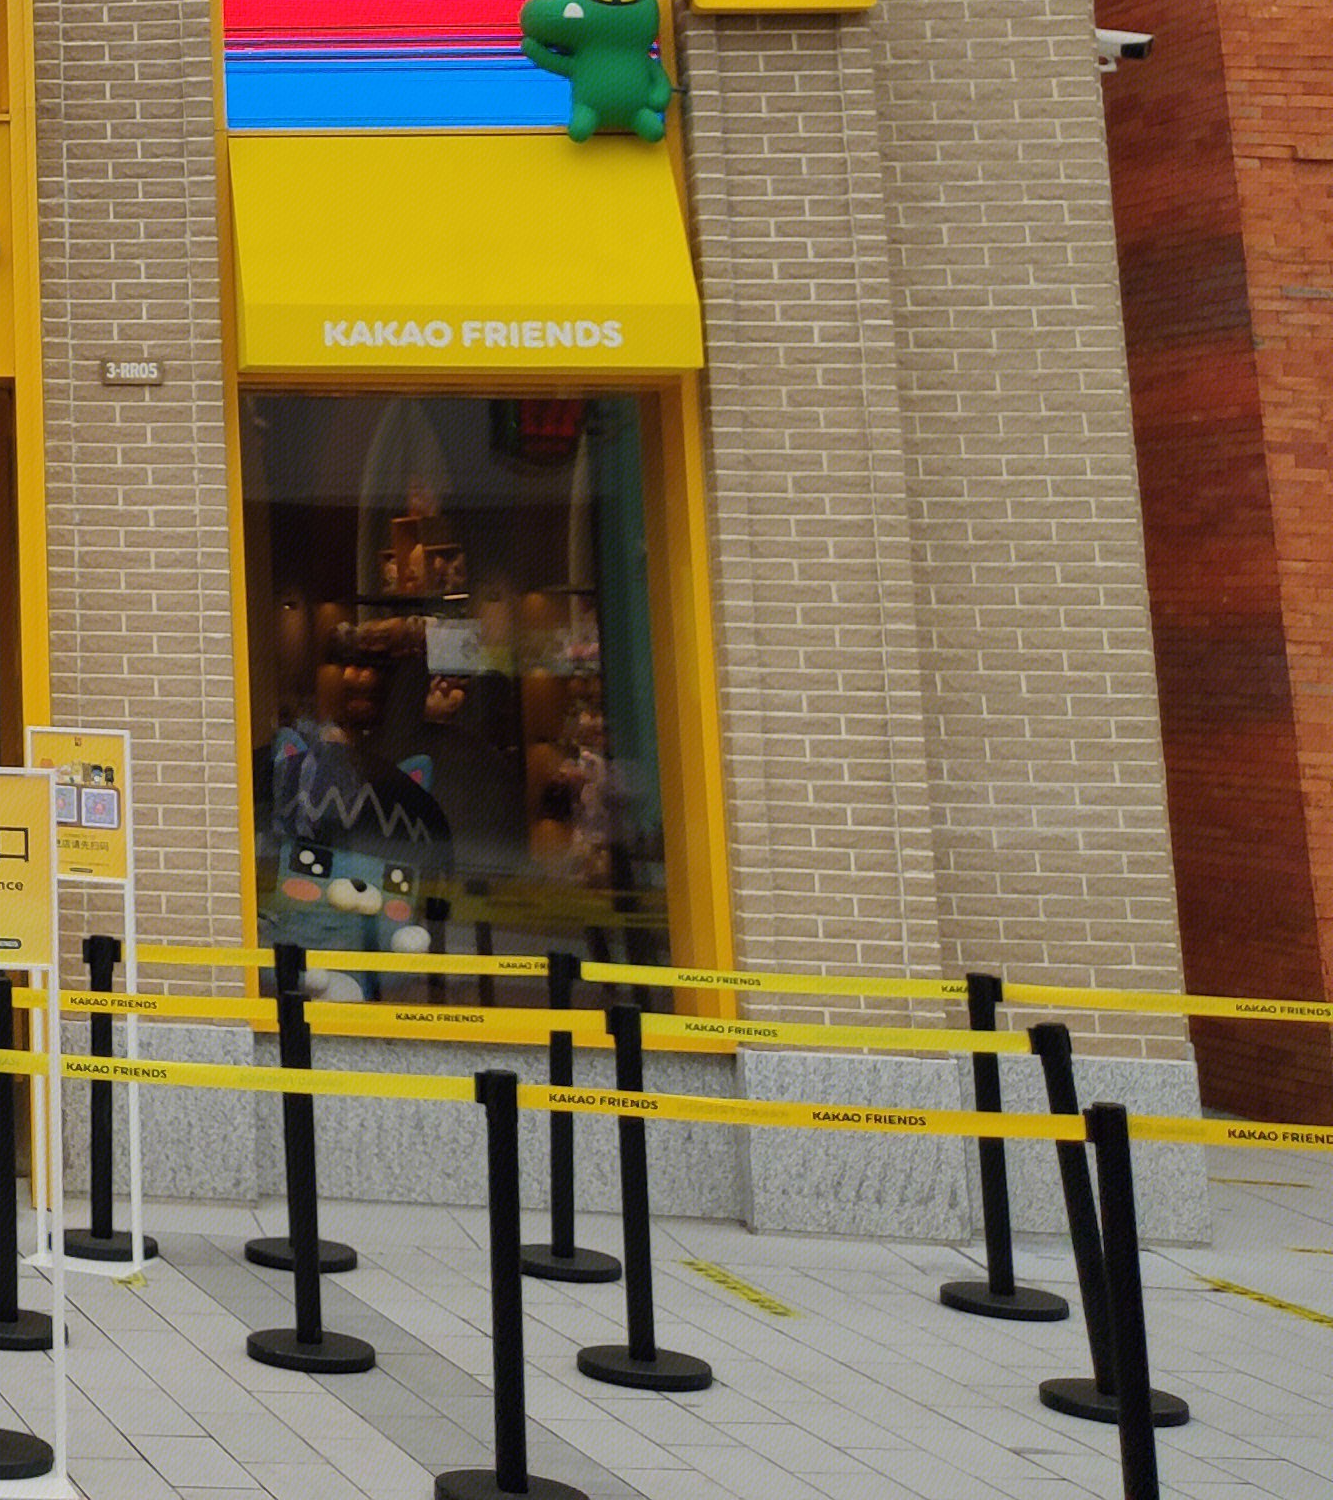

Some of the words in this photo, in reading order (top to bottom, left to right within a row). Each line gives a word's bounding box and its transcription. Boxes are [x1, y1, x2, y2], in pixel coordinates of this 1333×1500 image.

[323, 320, 452, 348] KAKAO
[461, 320, 624, 348] FRIENDS
[105, 362, 159, 379] 3-RR05
[677, 974, 714, 983] KAKAO
[716, 976, 761, 986] FRIENDS
[70, 997, 108, 1007] KAKAO
[111, 999, 157, 1010] FRIENDS
[1236, 1003, 1277, 1014] KAKAO
[1279, 1006, 1332, 1017] FRIENDS
[685, 1023, 725, 1034] KAKAO
[728, 1025, 778, 1038] FRIENDS
[66, 1062, 110, 1074] KAKAO
[113, 1066, 167, 1079] FRIENDS
[548, 1093, 596, 1105] KAKAO
[599, 1095, 659, 1110] FRIENDS
[812, 1111, 862, 1123] KAKAO
[865, 1113, 927, 1126] FRIENDS
[1227, 1127, 1278, 1142] KAKAO
